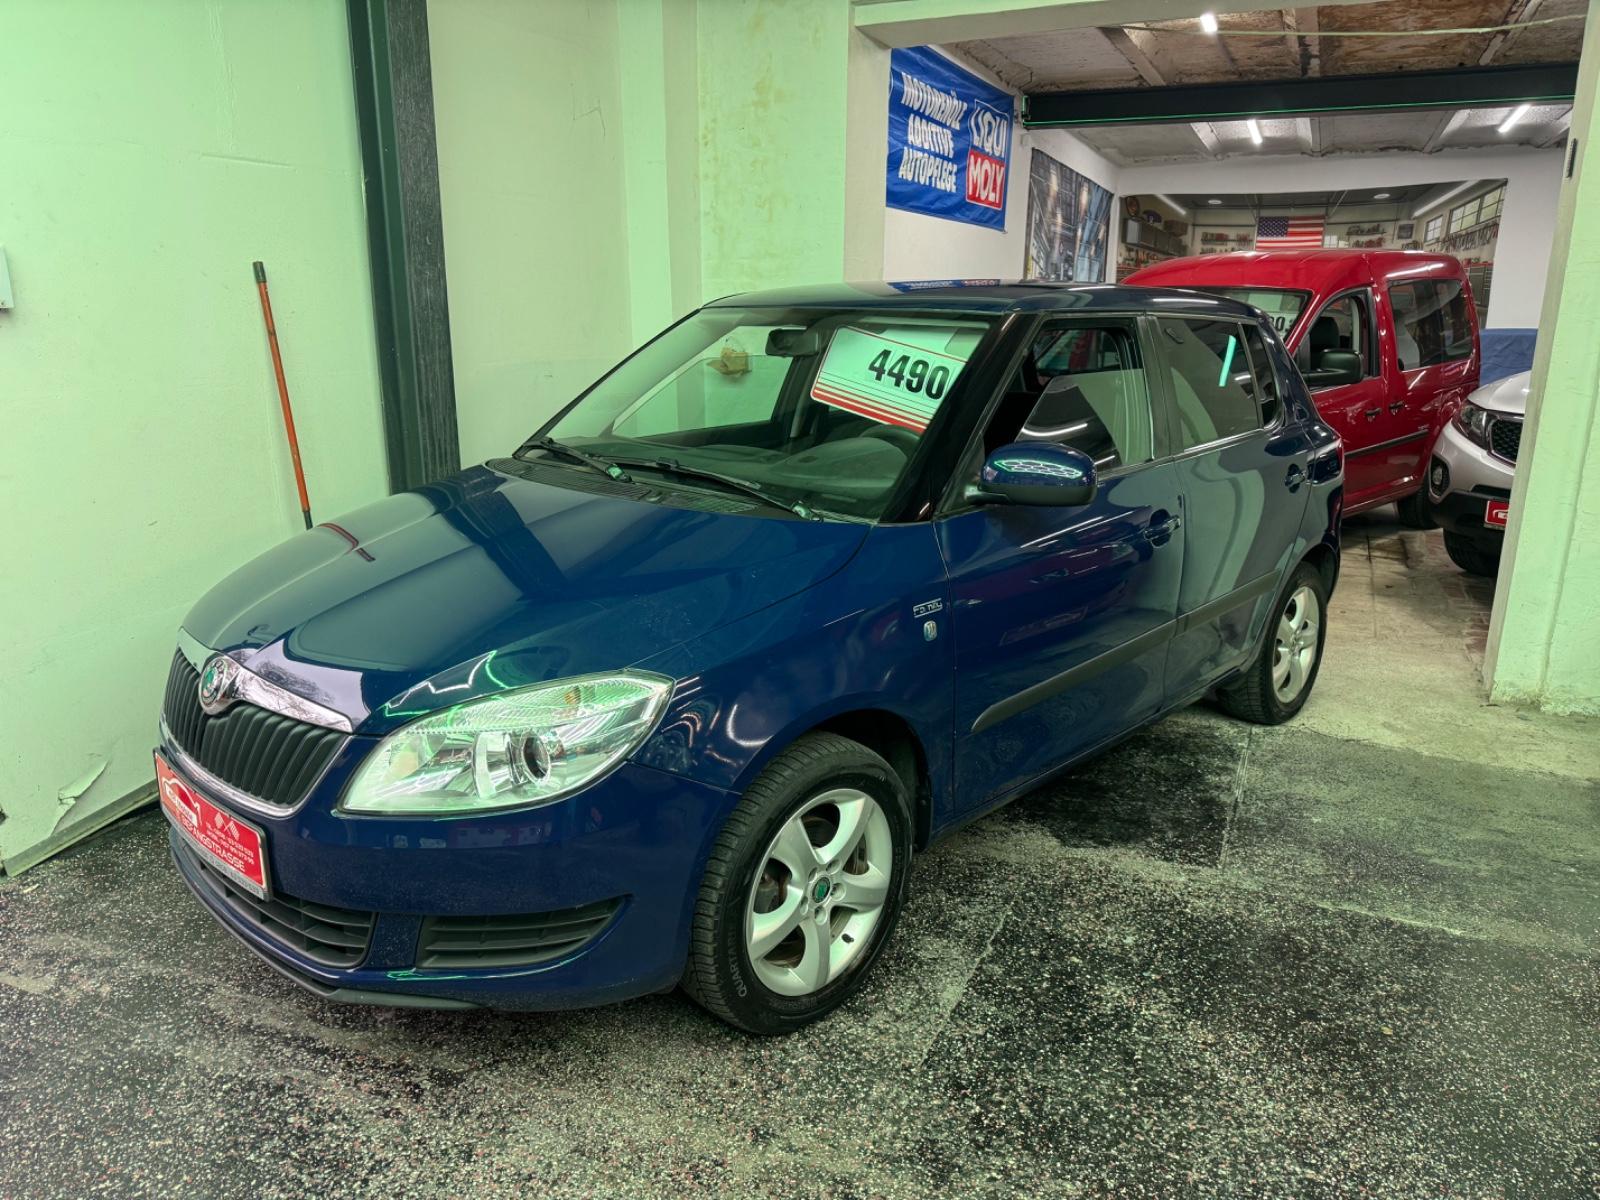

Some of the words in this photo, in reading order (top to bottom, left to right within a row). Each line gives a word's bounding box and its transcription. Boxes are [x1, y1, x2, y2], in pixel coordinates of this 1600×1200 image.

[908, 113, 954, 158] ADDITIVE
[971, 106, 1007, 158] LIQUI
[898, 146, 957, 193] AUTOPFLEGE
[968, 154, 1005, 204] MOLY
[868, 348, 950, 400] 4490
